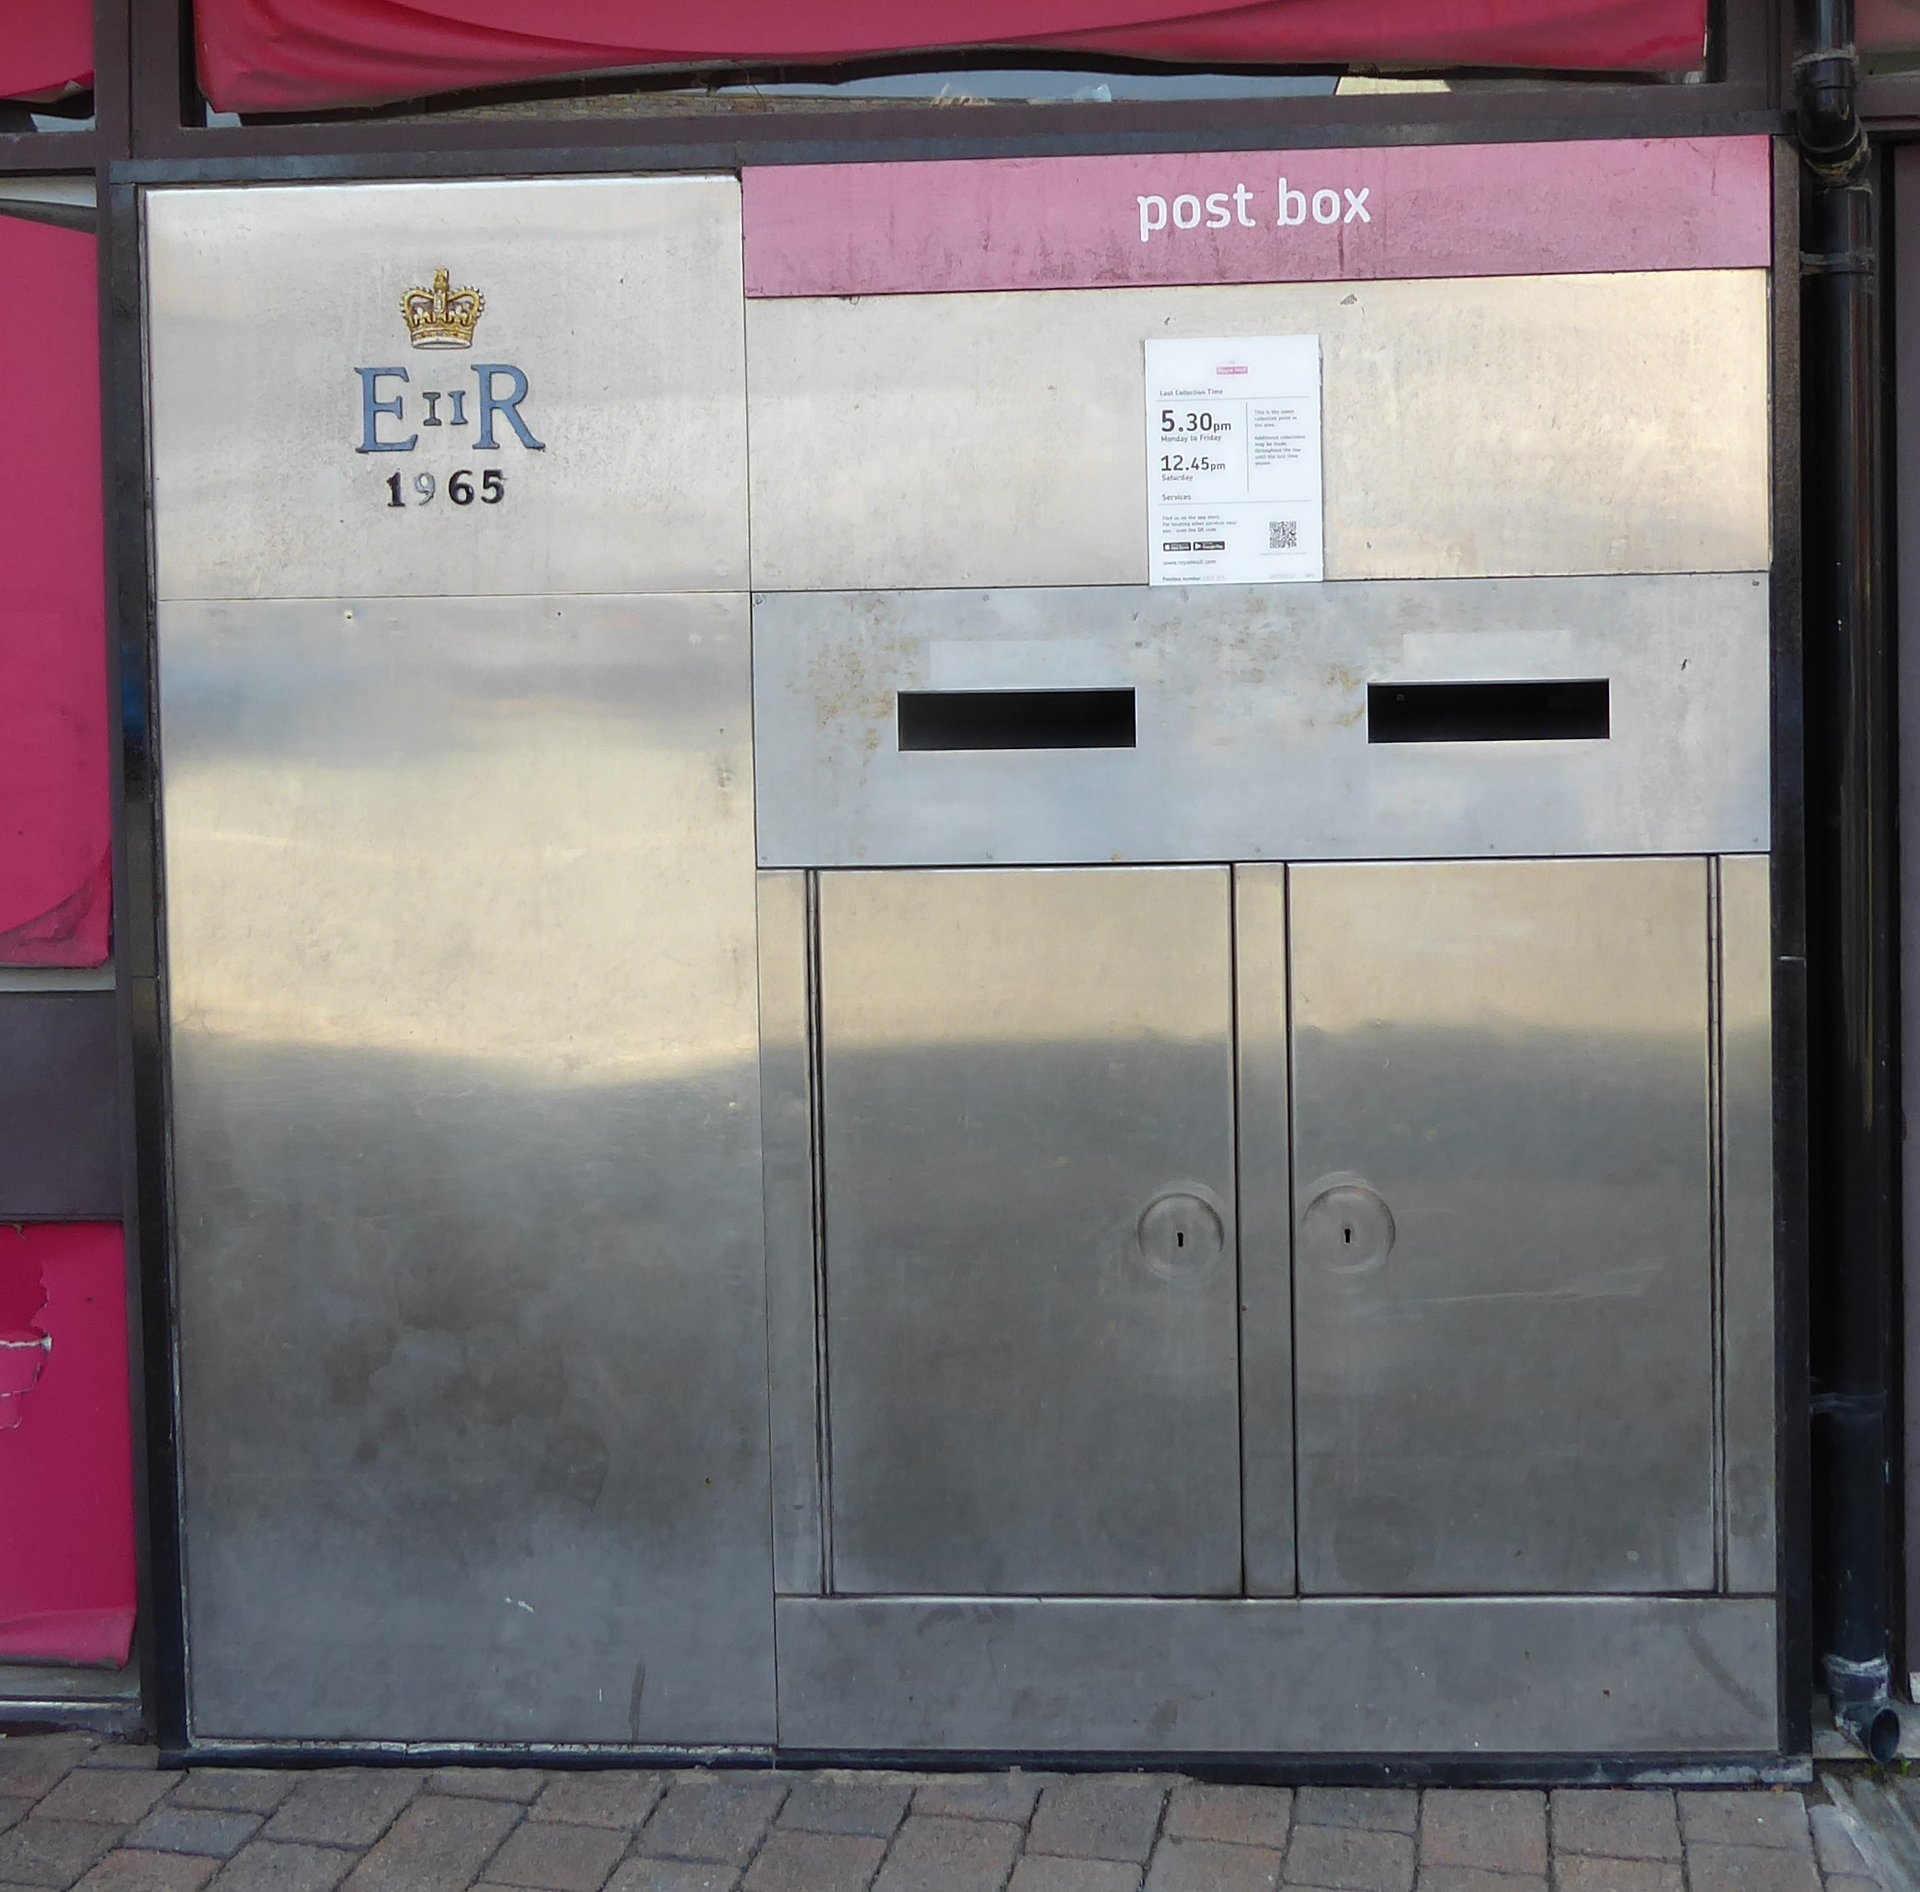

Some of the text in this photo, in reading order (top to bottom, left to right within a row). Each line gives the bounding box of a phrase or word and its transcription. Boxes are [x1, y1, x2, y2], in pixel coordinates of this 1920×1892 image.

[1137, 177, 1371, 243] post box
[1160, 389, 1174, 397] Last
[1161, 409, 1232, 433] 5.30pm
[1161, 435, 1188, 443] Monday
[1199, 434, 1222, 442] Friday
[1161, 454, 1226, 472] 12.45pm
[1161, 474, 1193, 482] Saturday
[386, 469, 508, 508] 1965
[1161, 493, 1192, 501] Services
